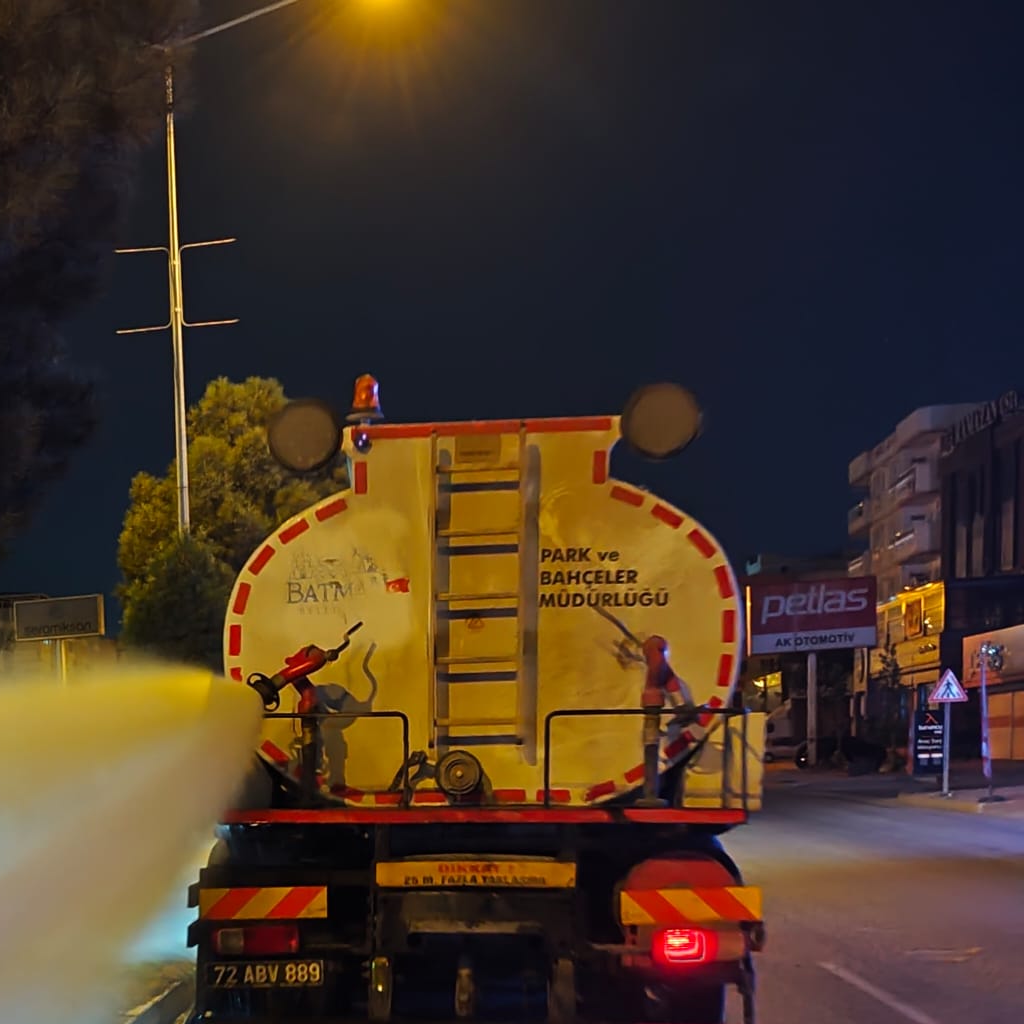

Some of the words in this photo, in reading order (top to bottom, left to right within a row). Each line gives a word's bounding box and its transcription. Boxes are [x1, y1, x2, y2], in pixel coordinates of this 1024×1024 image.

[541, 548, 591, 562] PARK
[597, 551, 620, 562] ve
[541, 570, 638, 588] BAHÇELER
[539, 588, 669, 607] MÜDÜRLÜĞÜ
[761, 584, 869, 625] petlas
[776, 638, 792, 647] AK
[794, 633, 855, 646] OTOMOTİV
[214, 965, 238, 985] 72
[243, 964, 279, 984] ABV
[285, 962, 321, 983] 889
